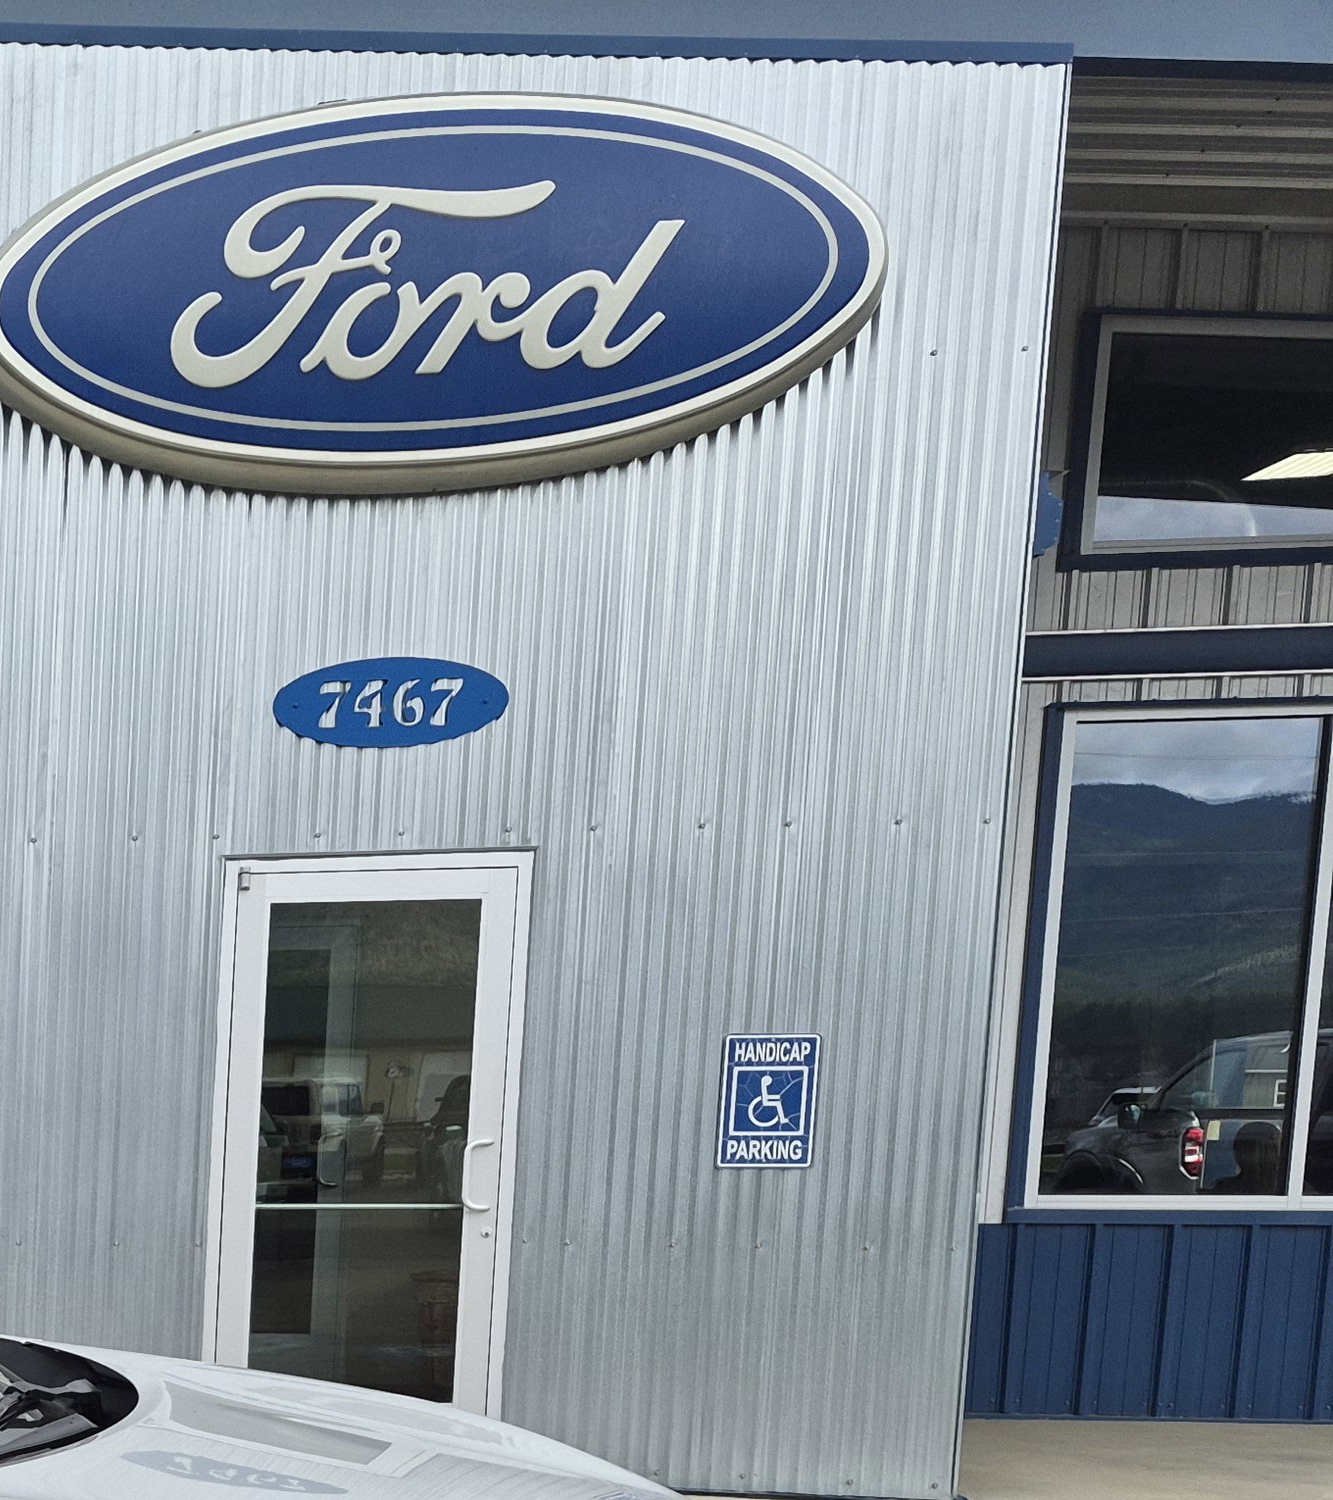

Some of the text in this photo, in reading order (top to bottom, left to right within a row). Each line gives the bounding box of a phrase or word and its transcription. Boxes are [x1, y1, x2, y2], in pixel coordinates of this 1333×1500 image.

[169, 178, 685, 388] Ford
[315, 676, 464, 729] 7467
[734, 1042, 811, 1063] HANDICAP
[726, 1139, 802, 1161] PARKING
